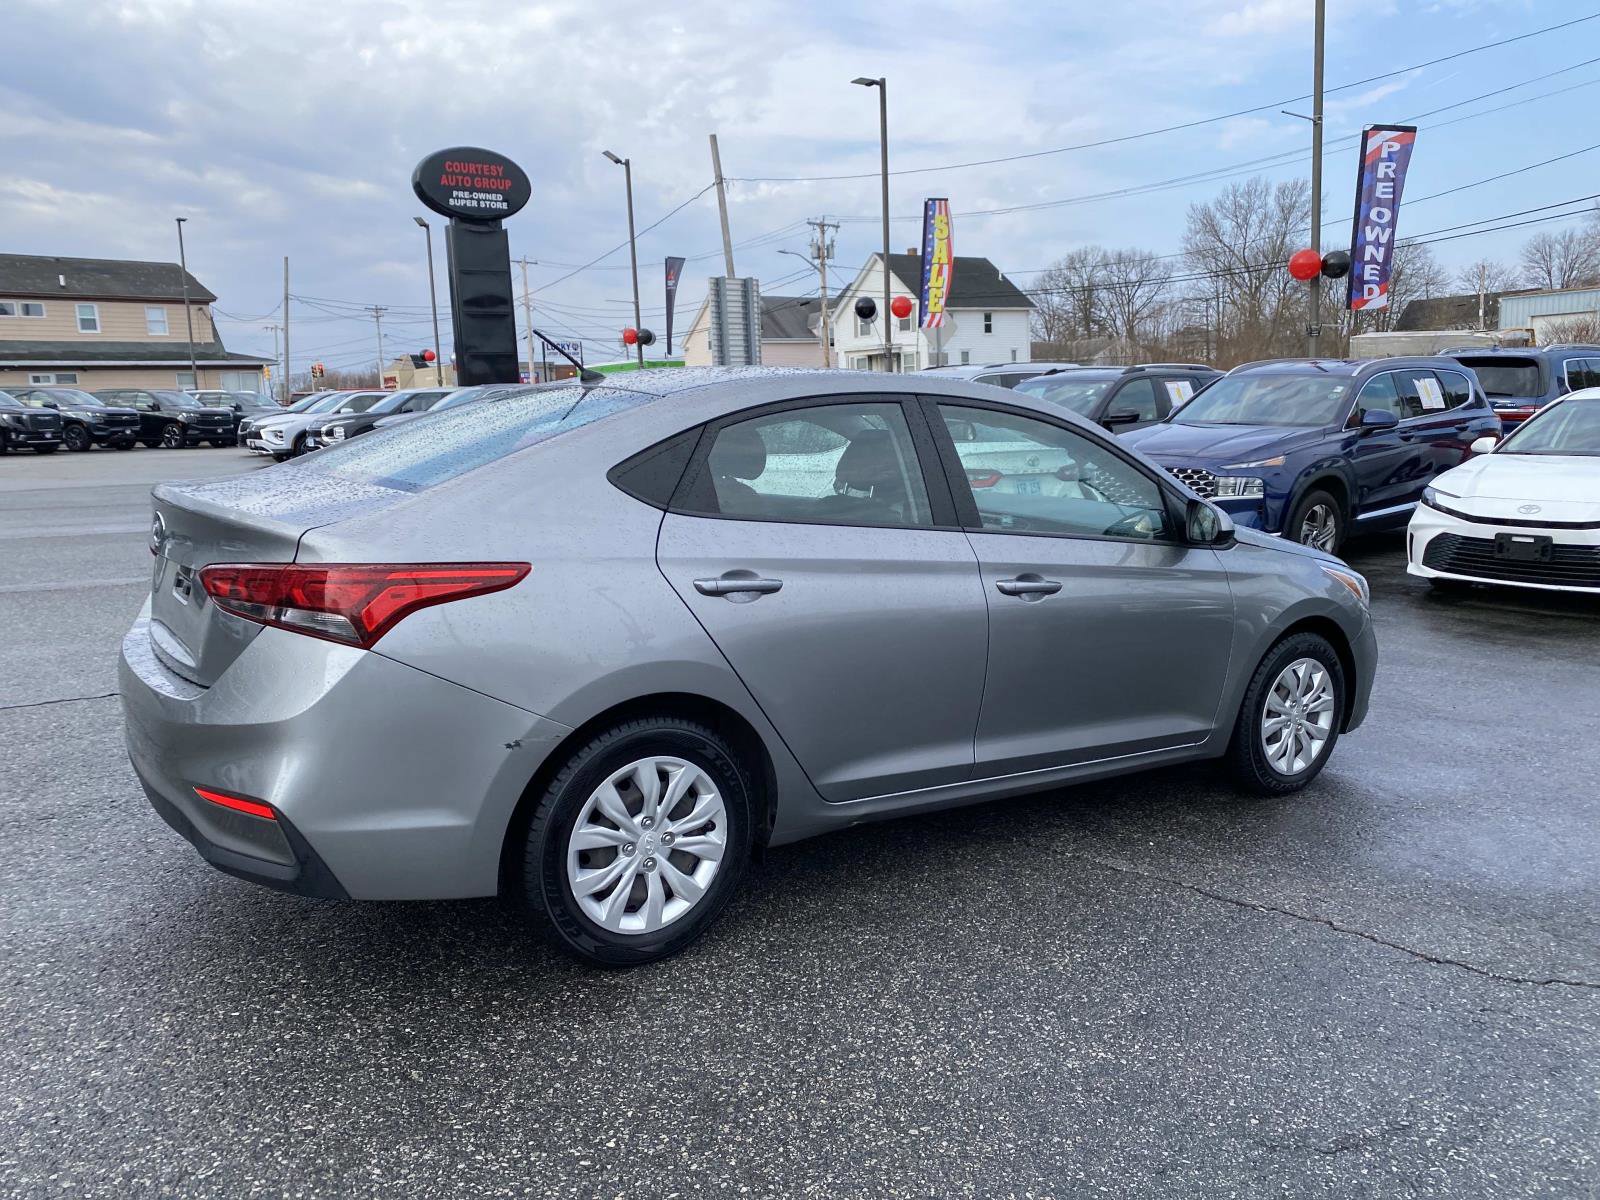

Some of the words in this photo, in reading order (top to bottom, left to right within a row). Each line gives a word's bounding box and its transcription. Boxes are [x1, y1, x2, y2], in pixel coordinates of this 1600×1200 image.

[444, 161, 504, 176] COURTESY
[1375, 141, 1401, 199] PRE
[440, 174, 472, 187] AUTO
[474, 176, 512, 191] GROUP
[448, 198, 478, 207] SUPER
[479, 200, 508, 209] STORE
[452, 190, 503, 201] PRE-OWNED
[1363, 206, 1393, 300] OWNED
[927, 214, 949, 313] SALE
